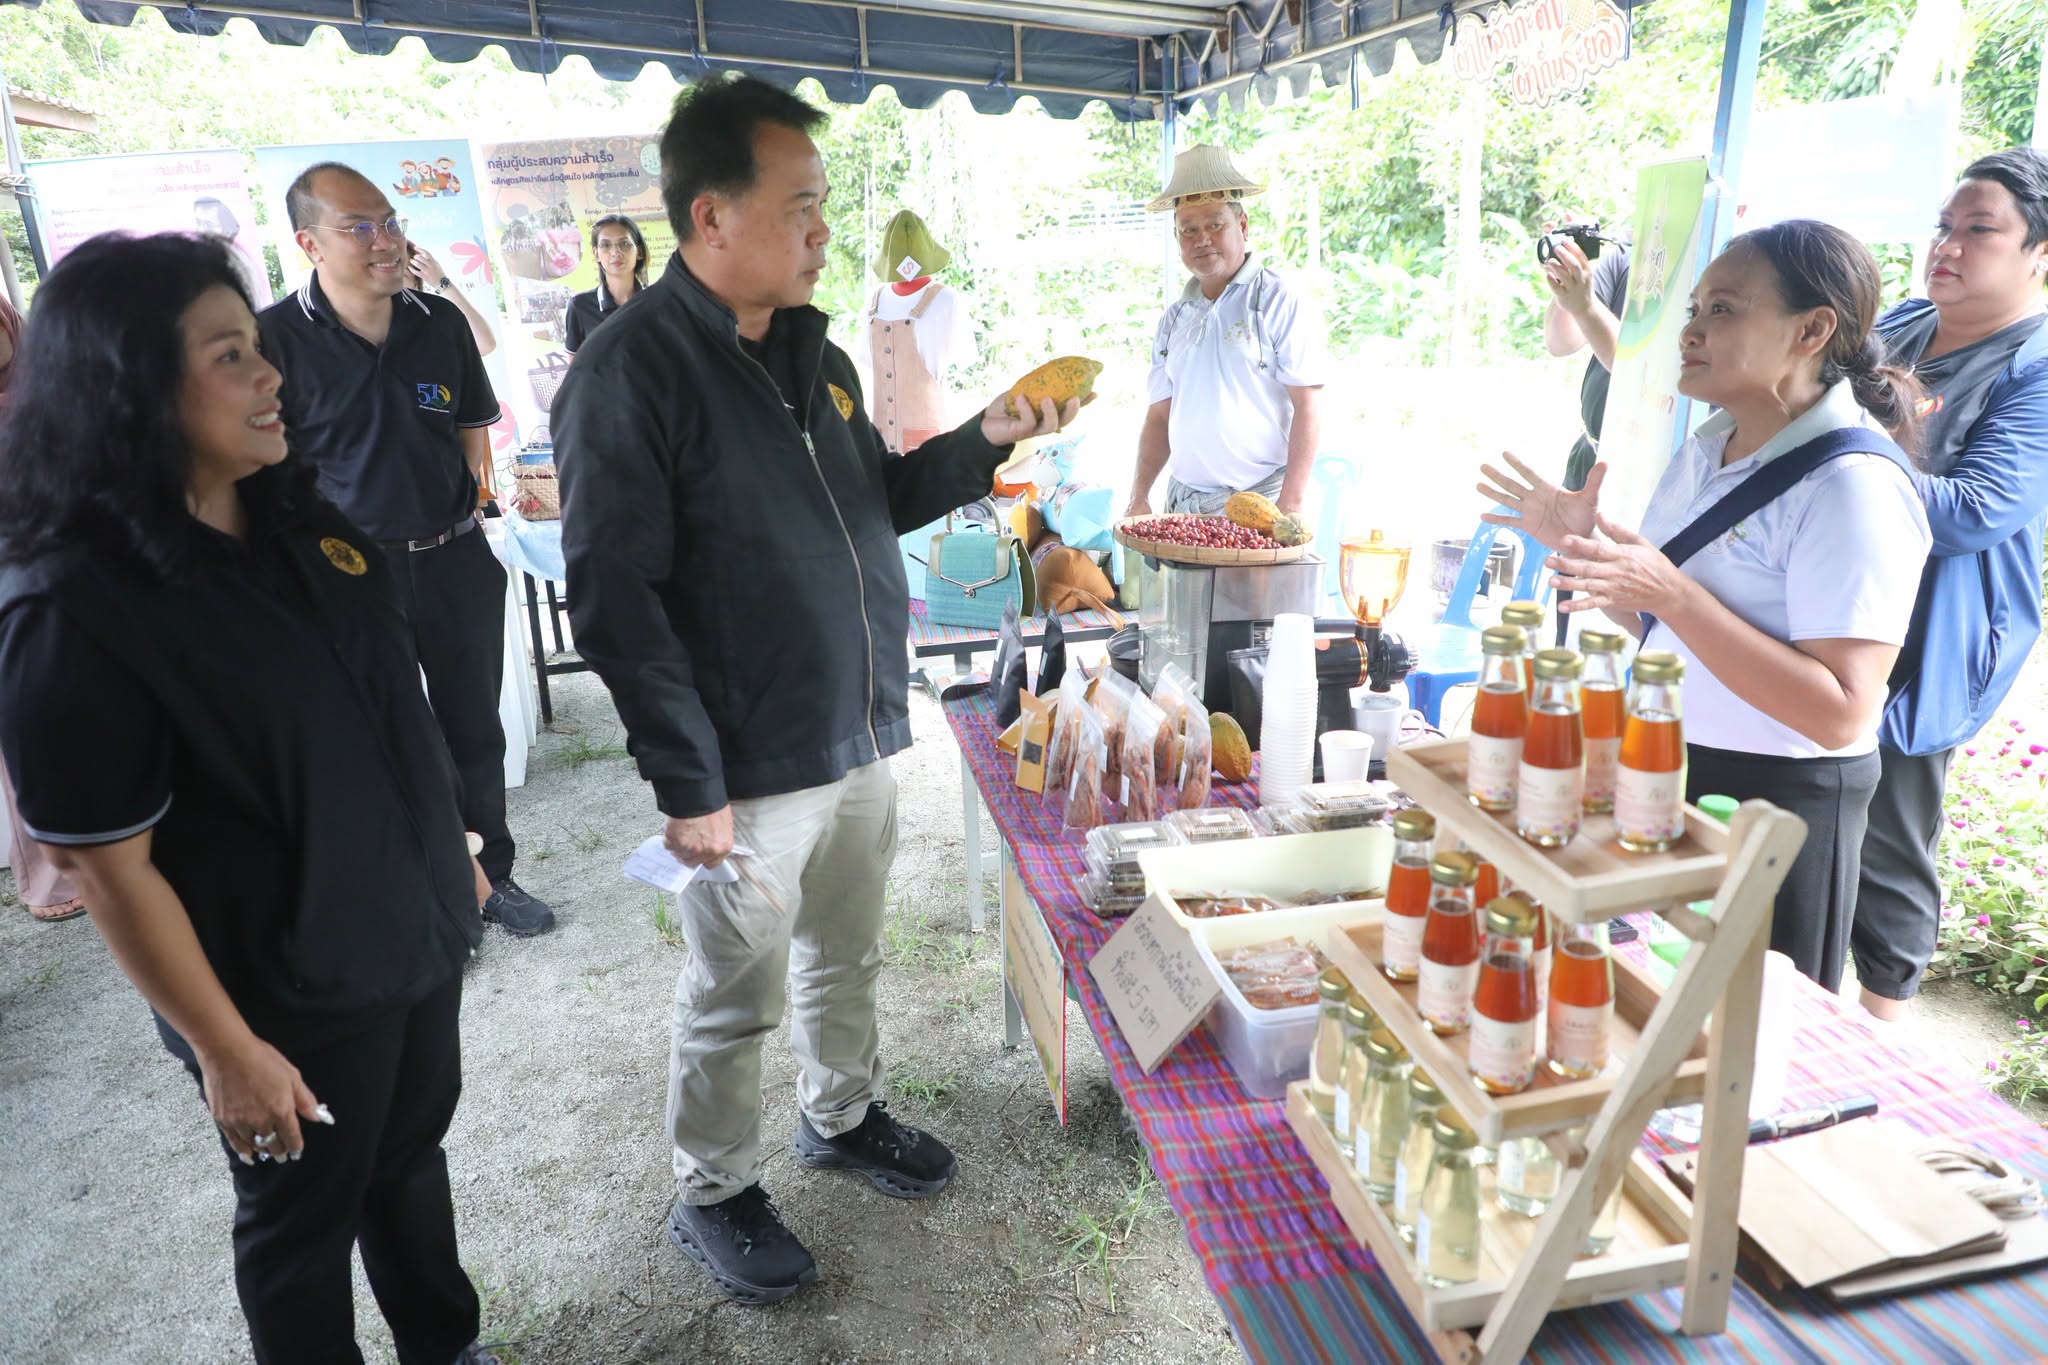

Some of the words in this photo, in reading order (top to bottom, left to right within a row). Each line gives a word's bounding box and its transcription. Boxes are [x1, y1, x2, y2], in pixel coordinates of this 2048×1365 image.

[488, 150, 614, 172] กลุ่มผู้ประสบความสำเร็จ
